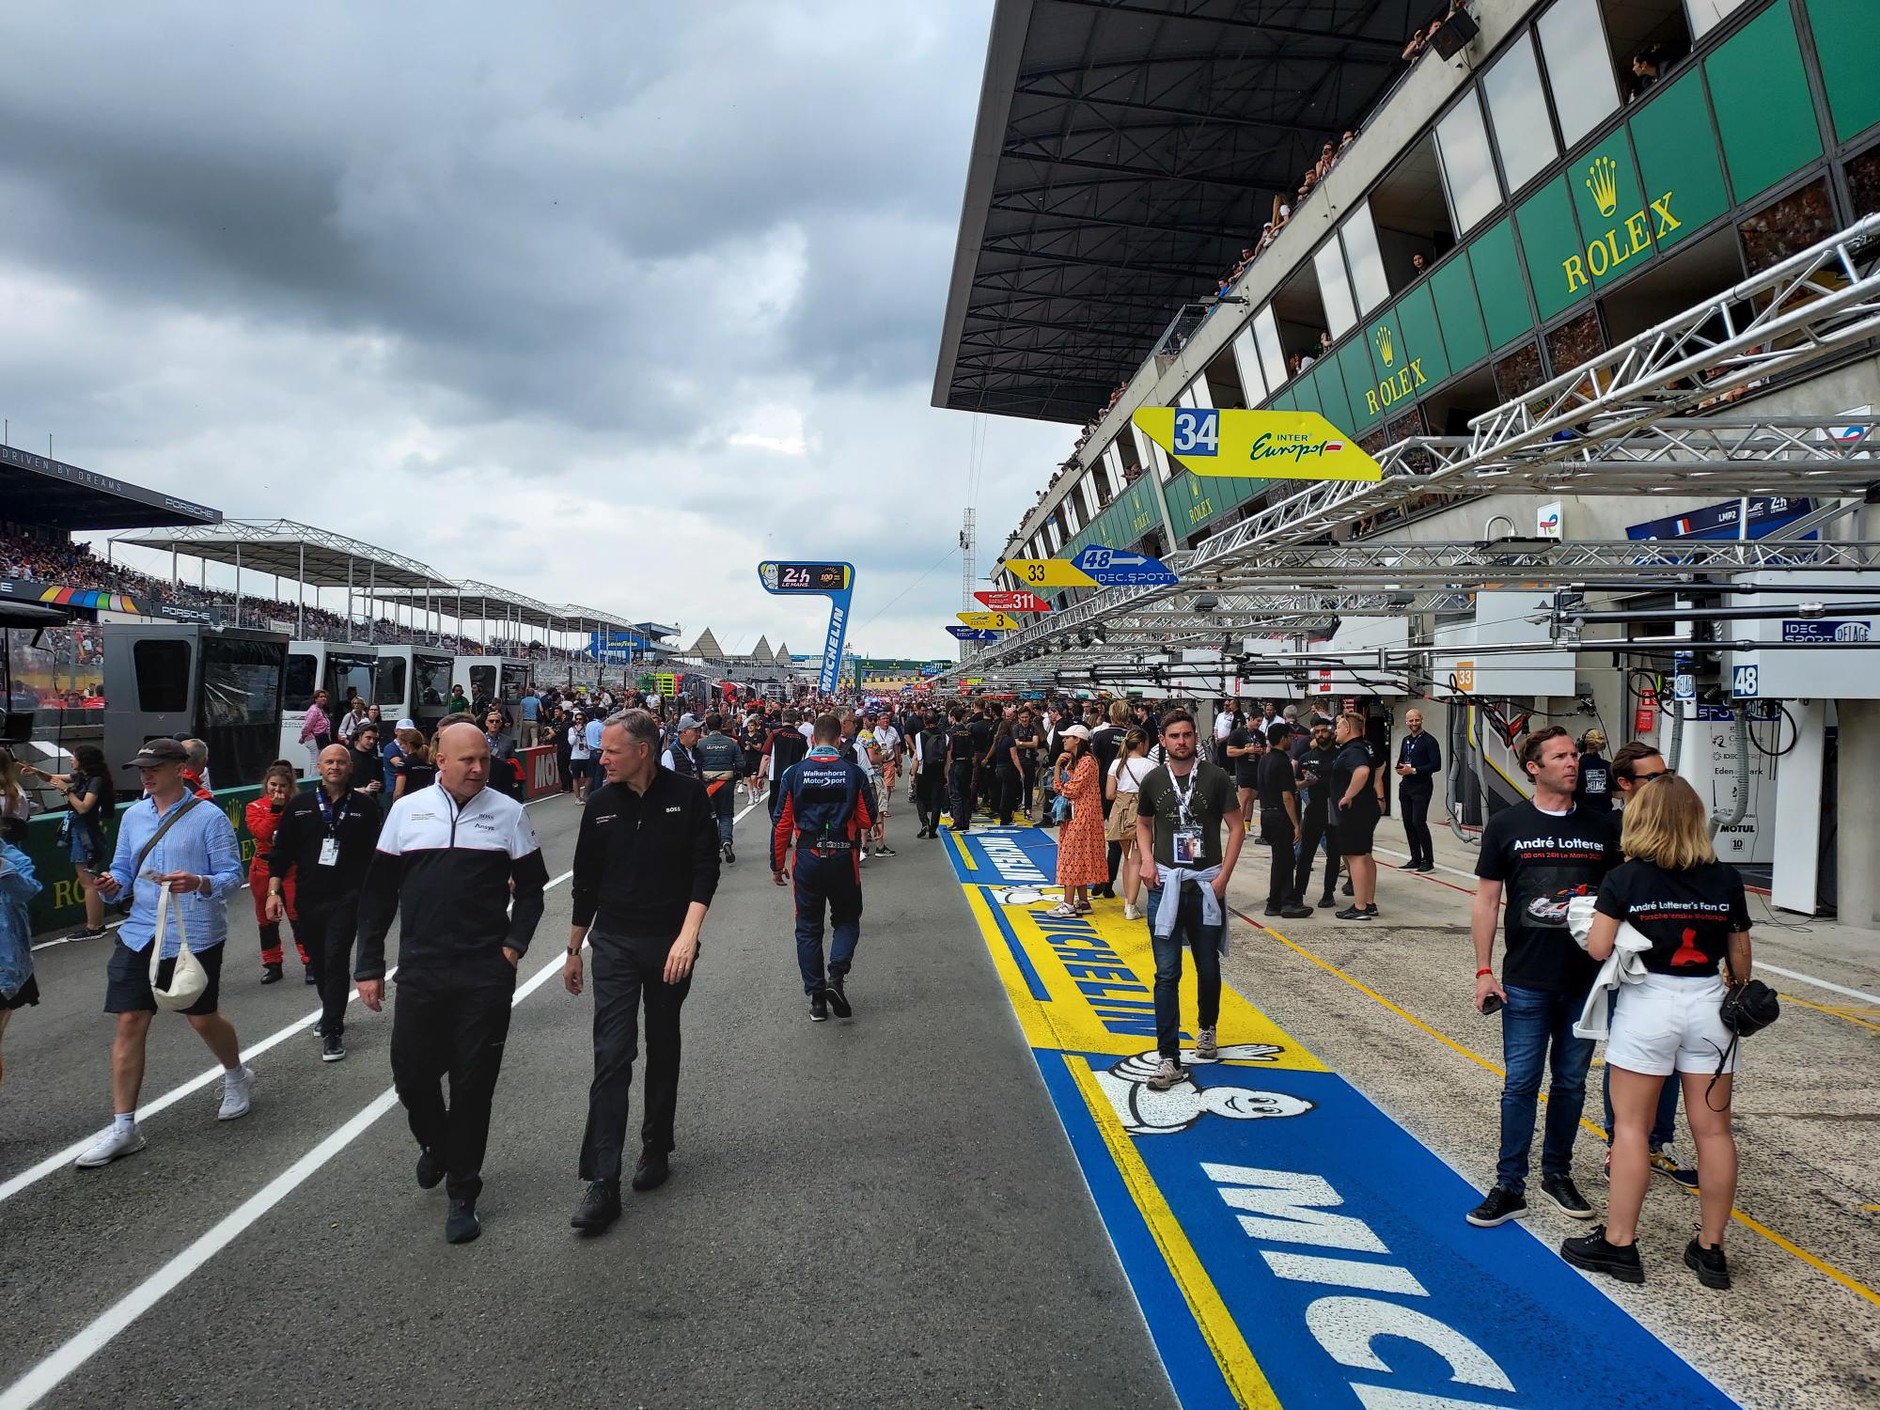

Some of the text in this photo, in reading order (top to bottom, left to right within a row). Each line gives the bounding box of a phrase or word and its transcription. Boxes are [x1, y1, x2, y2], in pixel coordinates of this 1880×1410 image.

[1562, 191, 1682, 294] ROLEX
[1364, 357, 1428, 416] ROLEX
[1174, 413, 1218, 452] 34
[1277, 433, 1308, 442] INTER
[1250, 432, 1327, 463] Europol
[2, 448, 122, 493] DRIVEN BY DREAMS
[164, 497, 214, 519] PORSCHE
[1188, 497, 1214, 525] ROLEX
[1718, 511, 1737, 522] LMP2
[1084, 551, 1111, 568] 48
[782, 568, 810, 583] 24h
[820, 573, 834, 581] 100
[1028, 565, 1045, 582] 33
[1012, 593, 1034, 609] 311
[161, 606, 211, 620] PORSCHE
[995, 614, 1004, 627] 3
[978, 629, 986, 639] 2
[1786, 624, 1818, 634] IDEC
[821, 606, 844, 692] MICHELIN
[1459, 670, 1472, 685] 33
[1735, 667, 1757, 695] 48
[534, 753, 560, 789] MOT
[1714, 766, 1734, 775] Eden
[475, 823, 495, 831] Ansys
[1720, 825, 1755, 833] MOTUL
[1513, 837, 1555, 851] André
[1732, 840, 1743, 848] 10
[1629, 901, 1657, 913] André
[1659, 902, 1699, 910] Lotterer's
[1700, 902, 1718, 911] Fan
[1027, 910, 1194, 1040] MICHELIN
[1200, 1162, 1520, 1410] MIC
